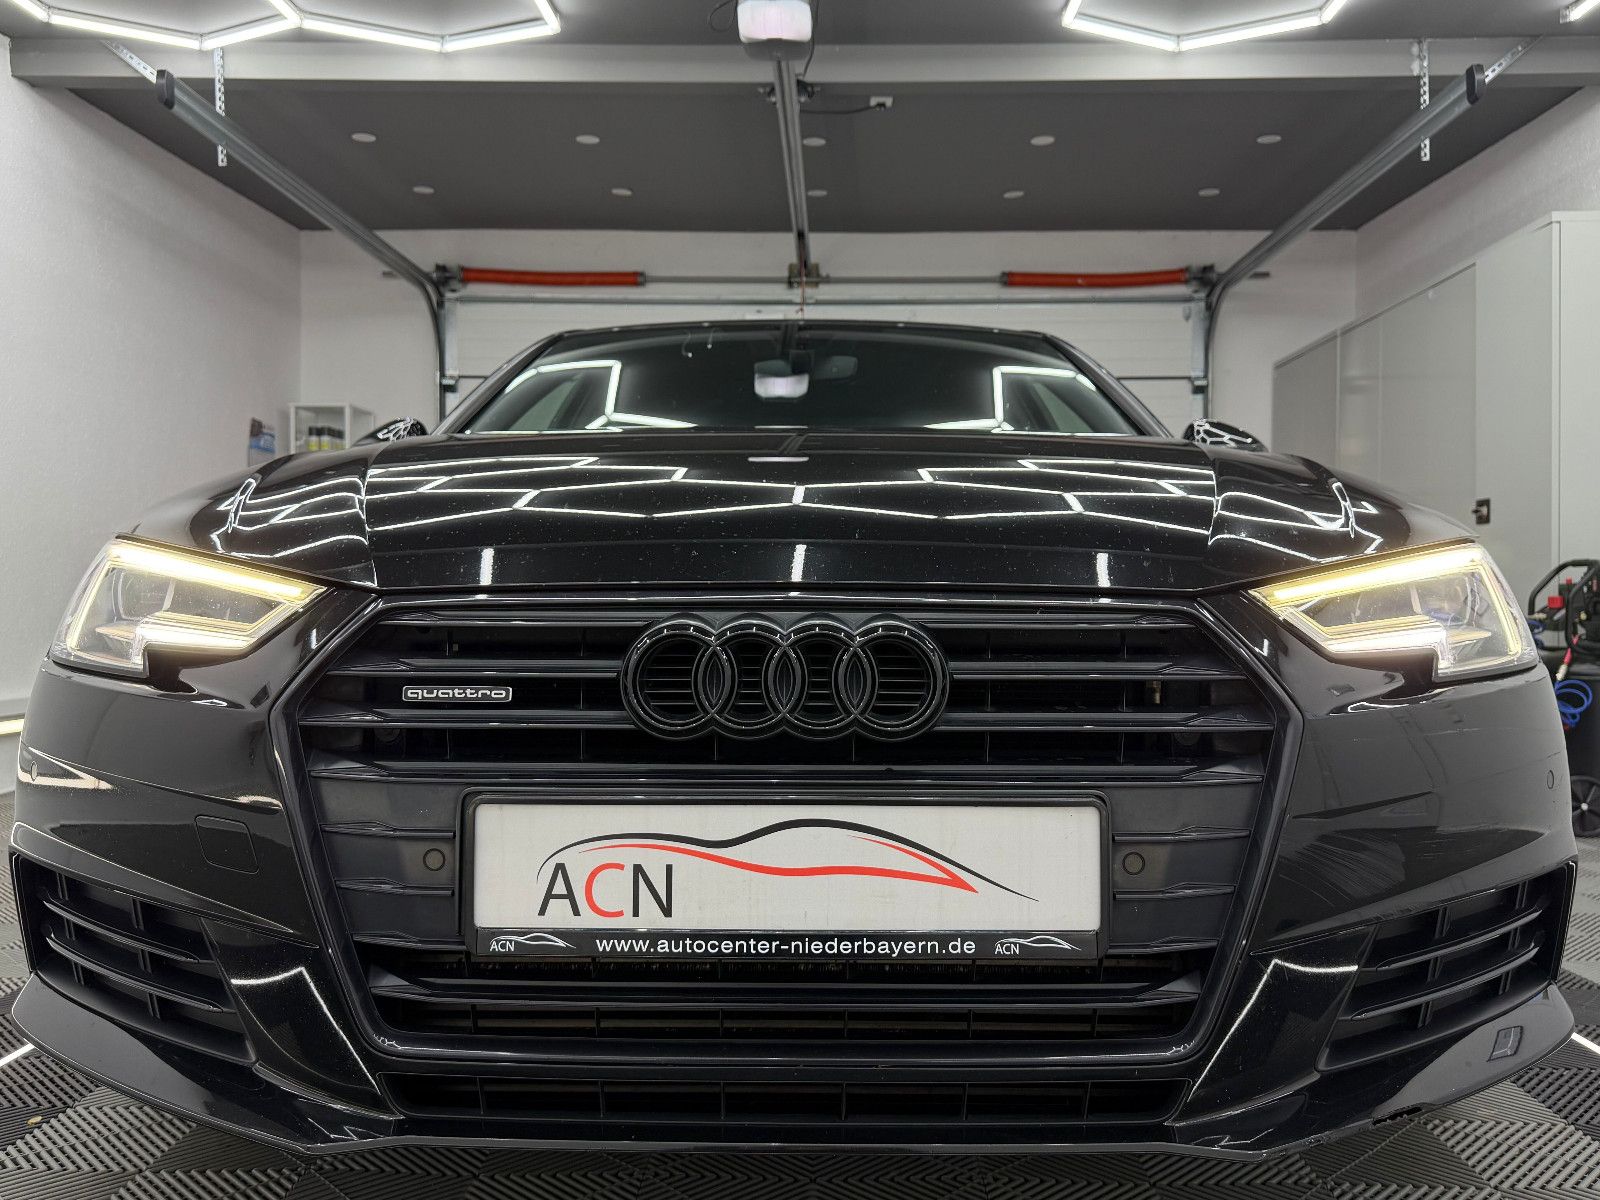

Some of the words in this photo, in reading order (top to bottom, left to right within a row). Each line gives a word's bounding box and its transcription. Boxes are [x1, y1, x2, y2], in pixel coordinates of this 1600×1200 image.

[407, 688, 506, 699] quattro
[537, 862, 673, 918] ACN
[489, 940, 515, 952] ACN
[595, 937, 976, 957] www.autocenter-niederbayern.de
[994, 943, 1020, 955] ACN
